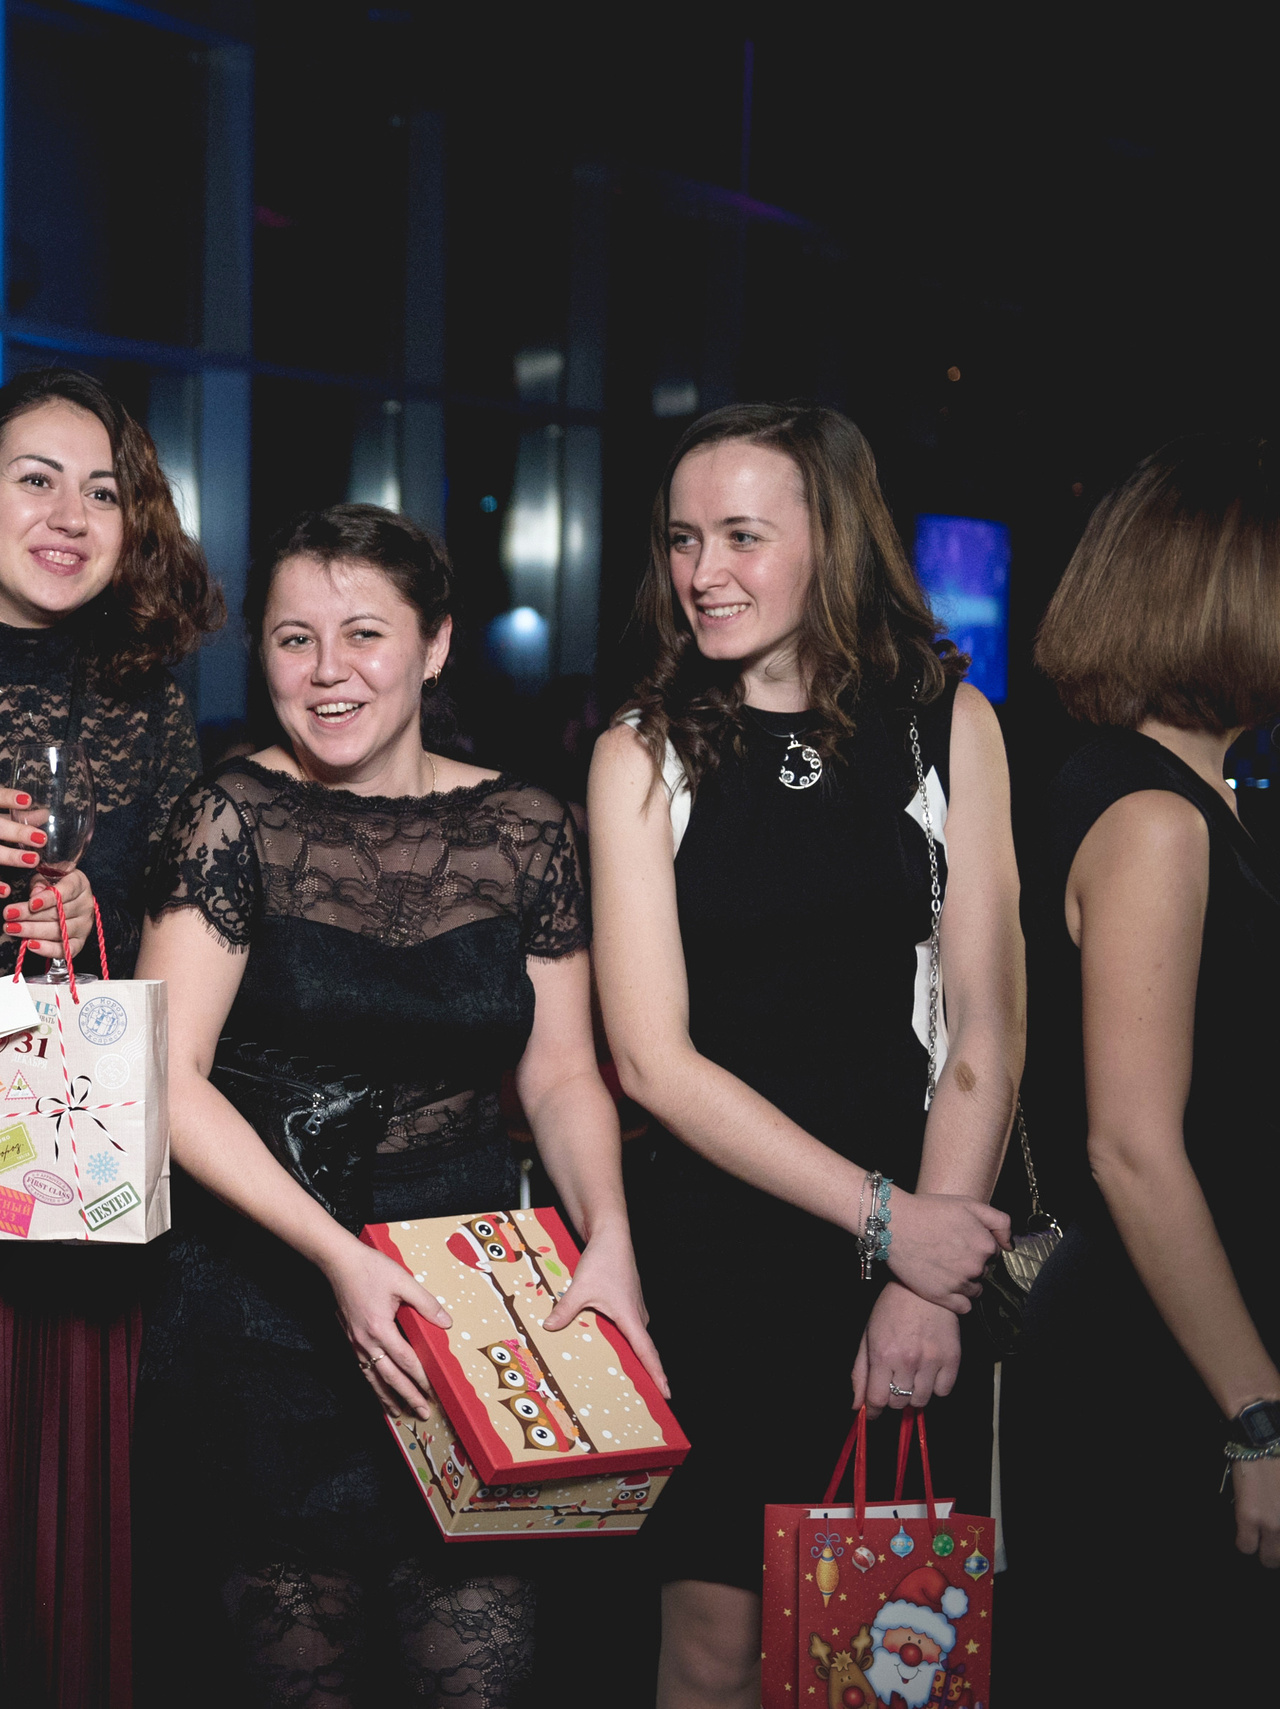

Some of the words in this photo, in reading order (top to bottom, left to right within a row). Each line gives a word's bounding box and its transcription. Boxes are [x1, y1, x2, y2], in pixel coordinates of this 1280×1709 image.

[14, 1032, 48, 1059] 31
[26, 1176, 48, 1190] FIRST
[48, 1186, 70, 1200] CLASS
[87, 1191, 133, 1223] TESTED
